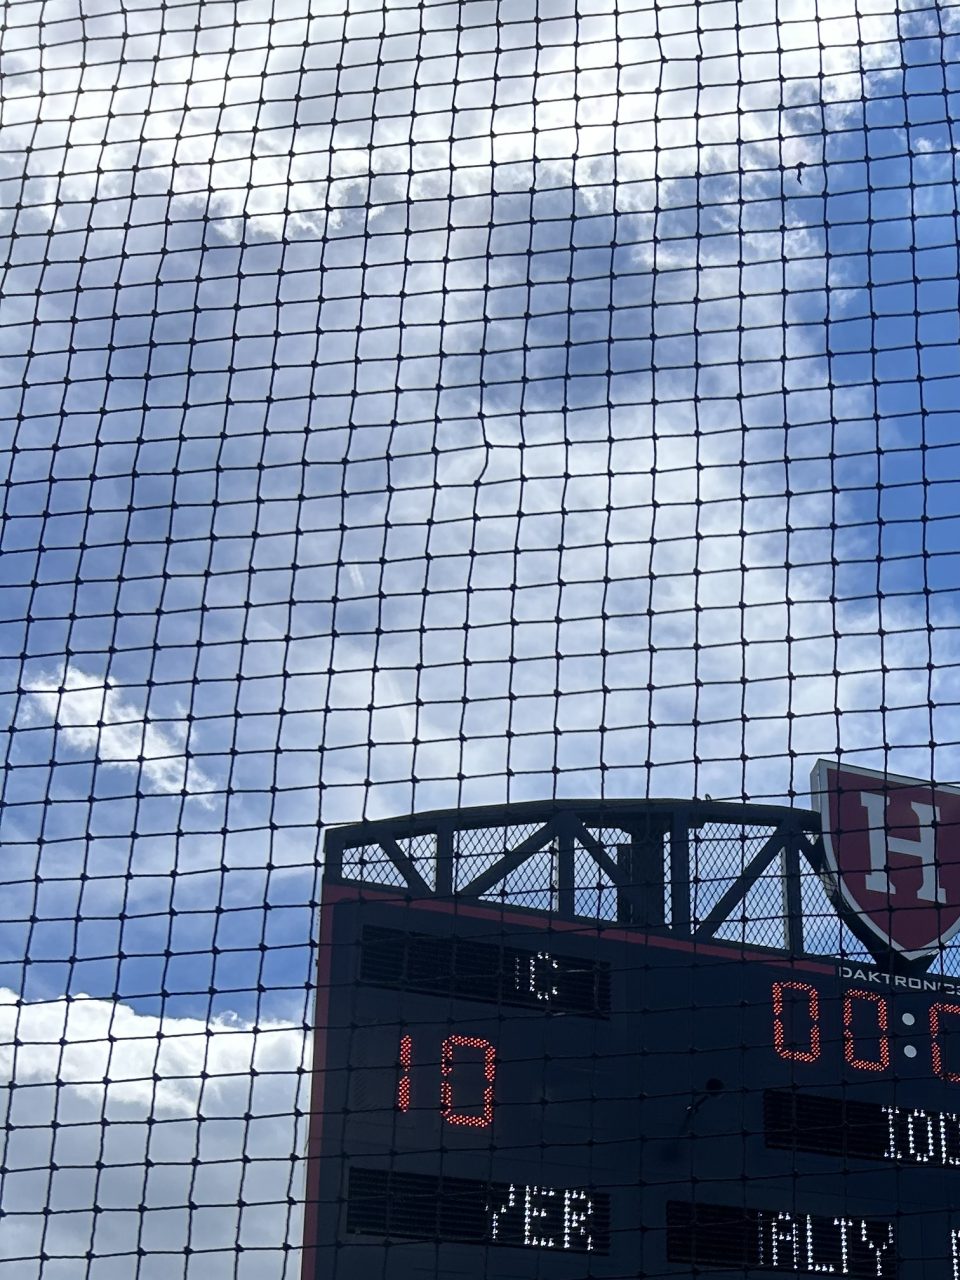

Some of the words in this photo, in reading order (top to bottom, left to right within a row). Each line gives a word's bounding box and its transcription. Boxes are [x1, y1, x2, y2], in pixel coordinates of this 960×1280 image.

[859, 790, 947, 905] H
[397, 1033, 497, 1128] 10
[757, 1211, 894, 1277] ALTY
